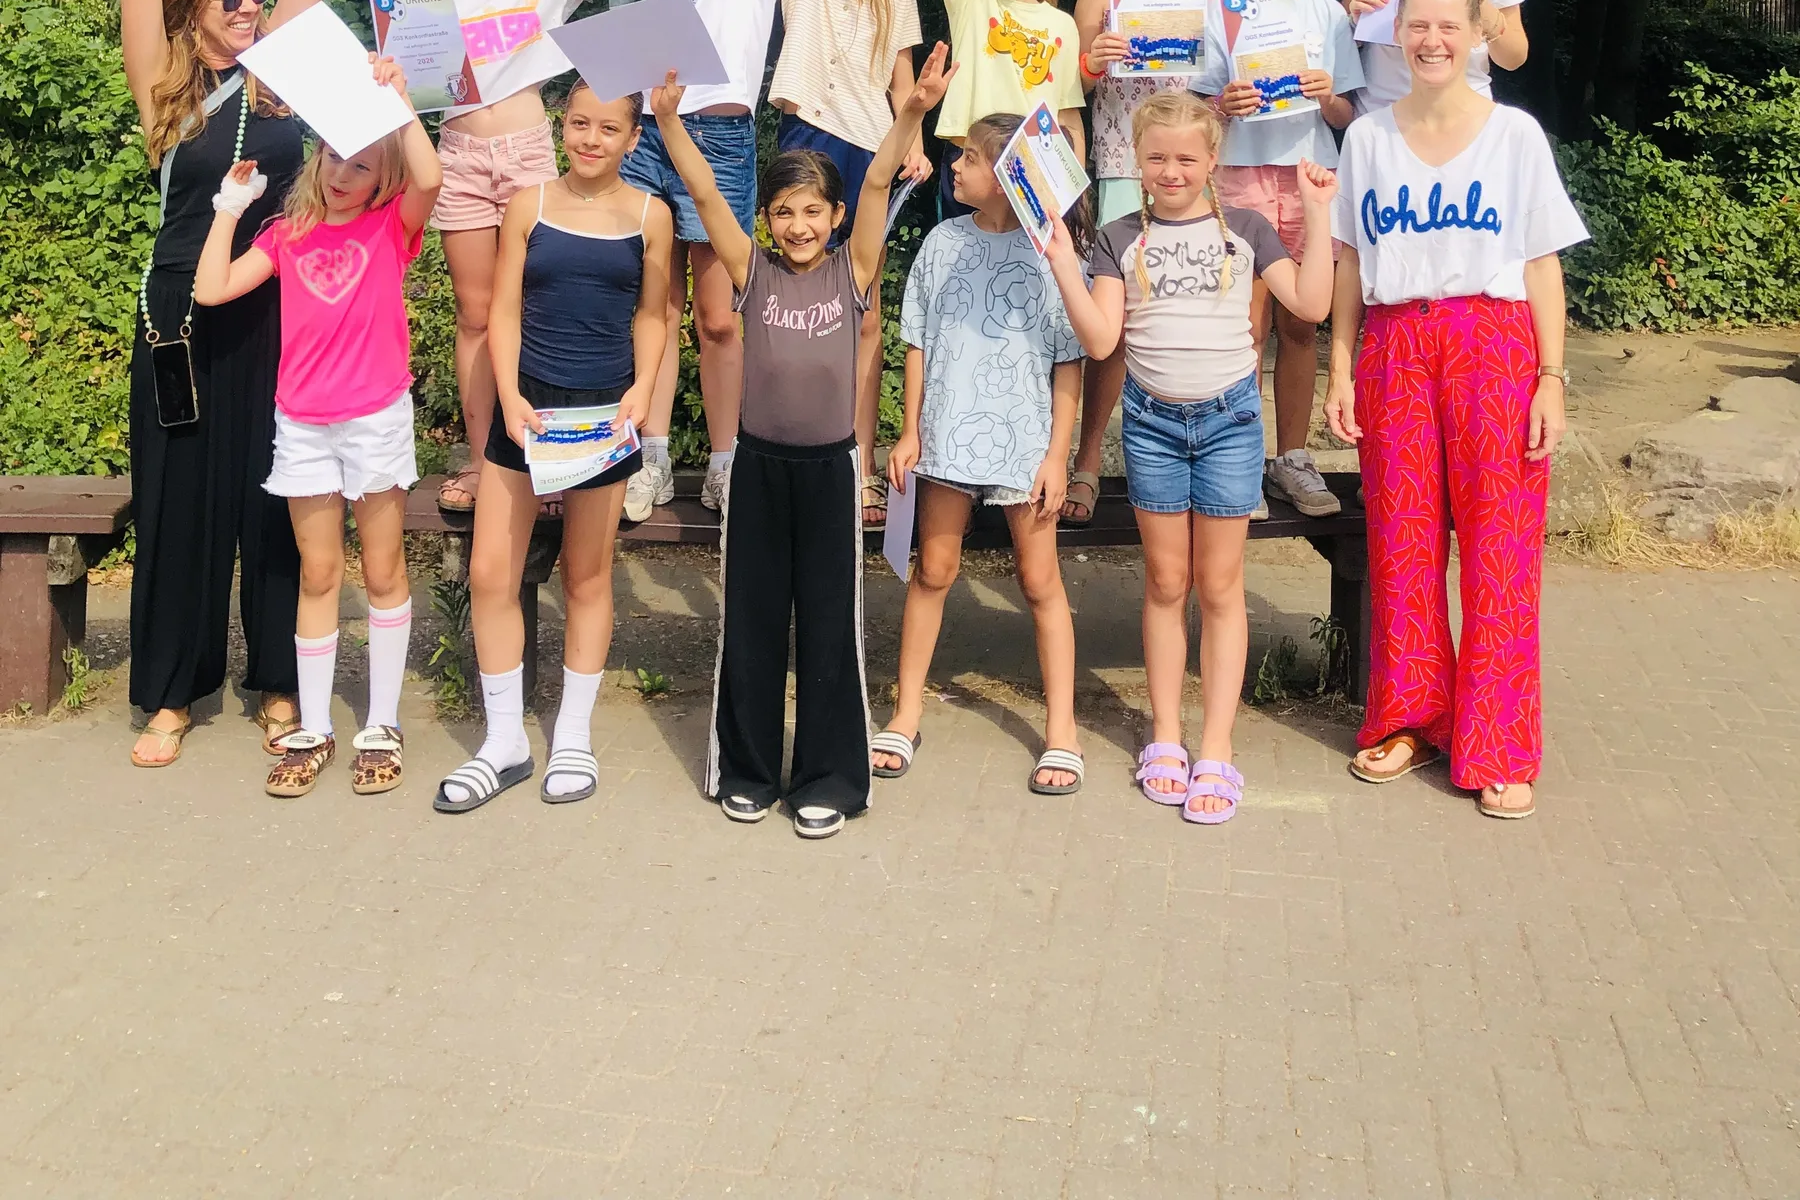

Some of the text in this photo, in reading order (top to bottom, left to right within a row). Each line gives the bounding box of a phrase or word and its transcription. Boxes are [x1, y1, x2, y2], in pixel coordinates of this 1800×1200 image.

[1039, 114, 1050, 129] B
[1054, 143, 1081, 190] URKUNDE
[540, 466, 596, 485] URKUNDE
